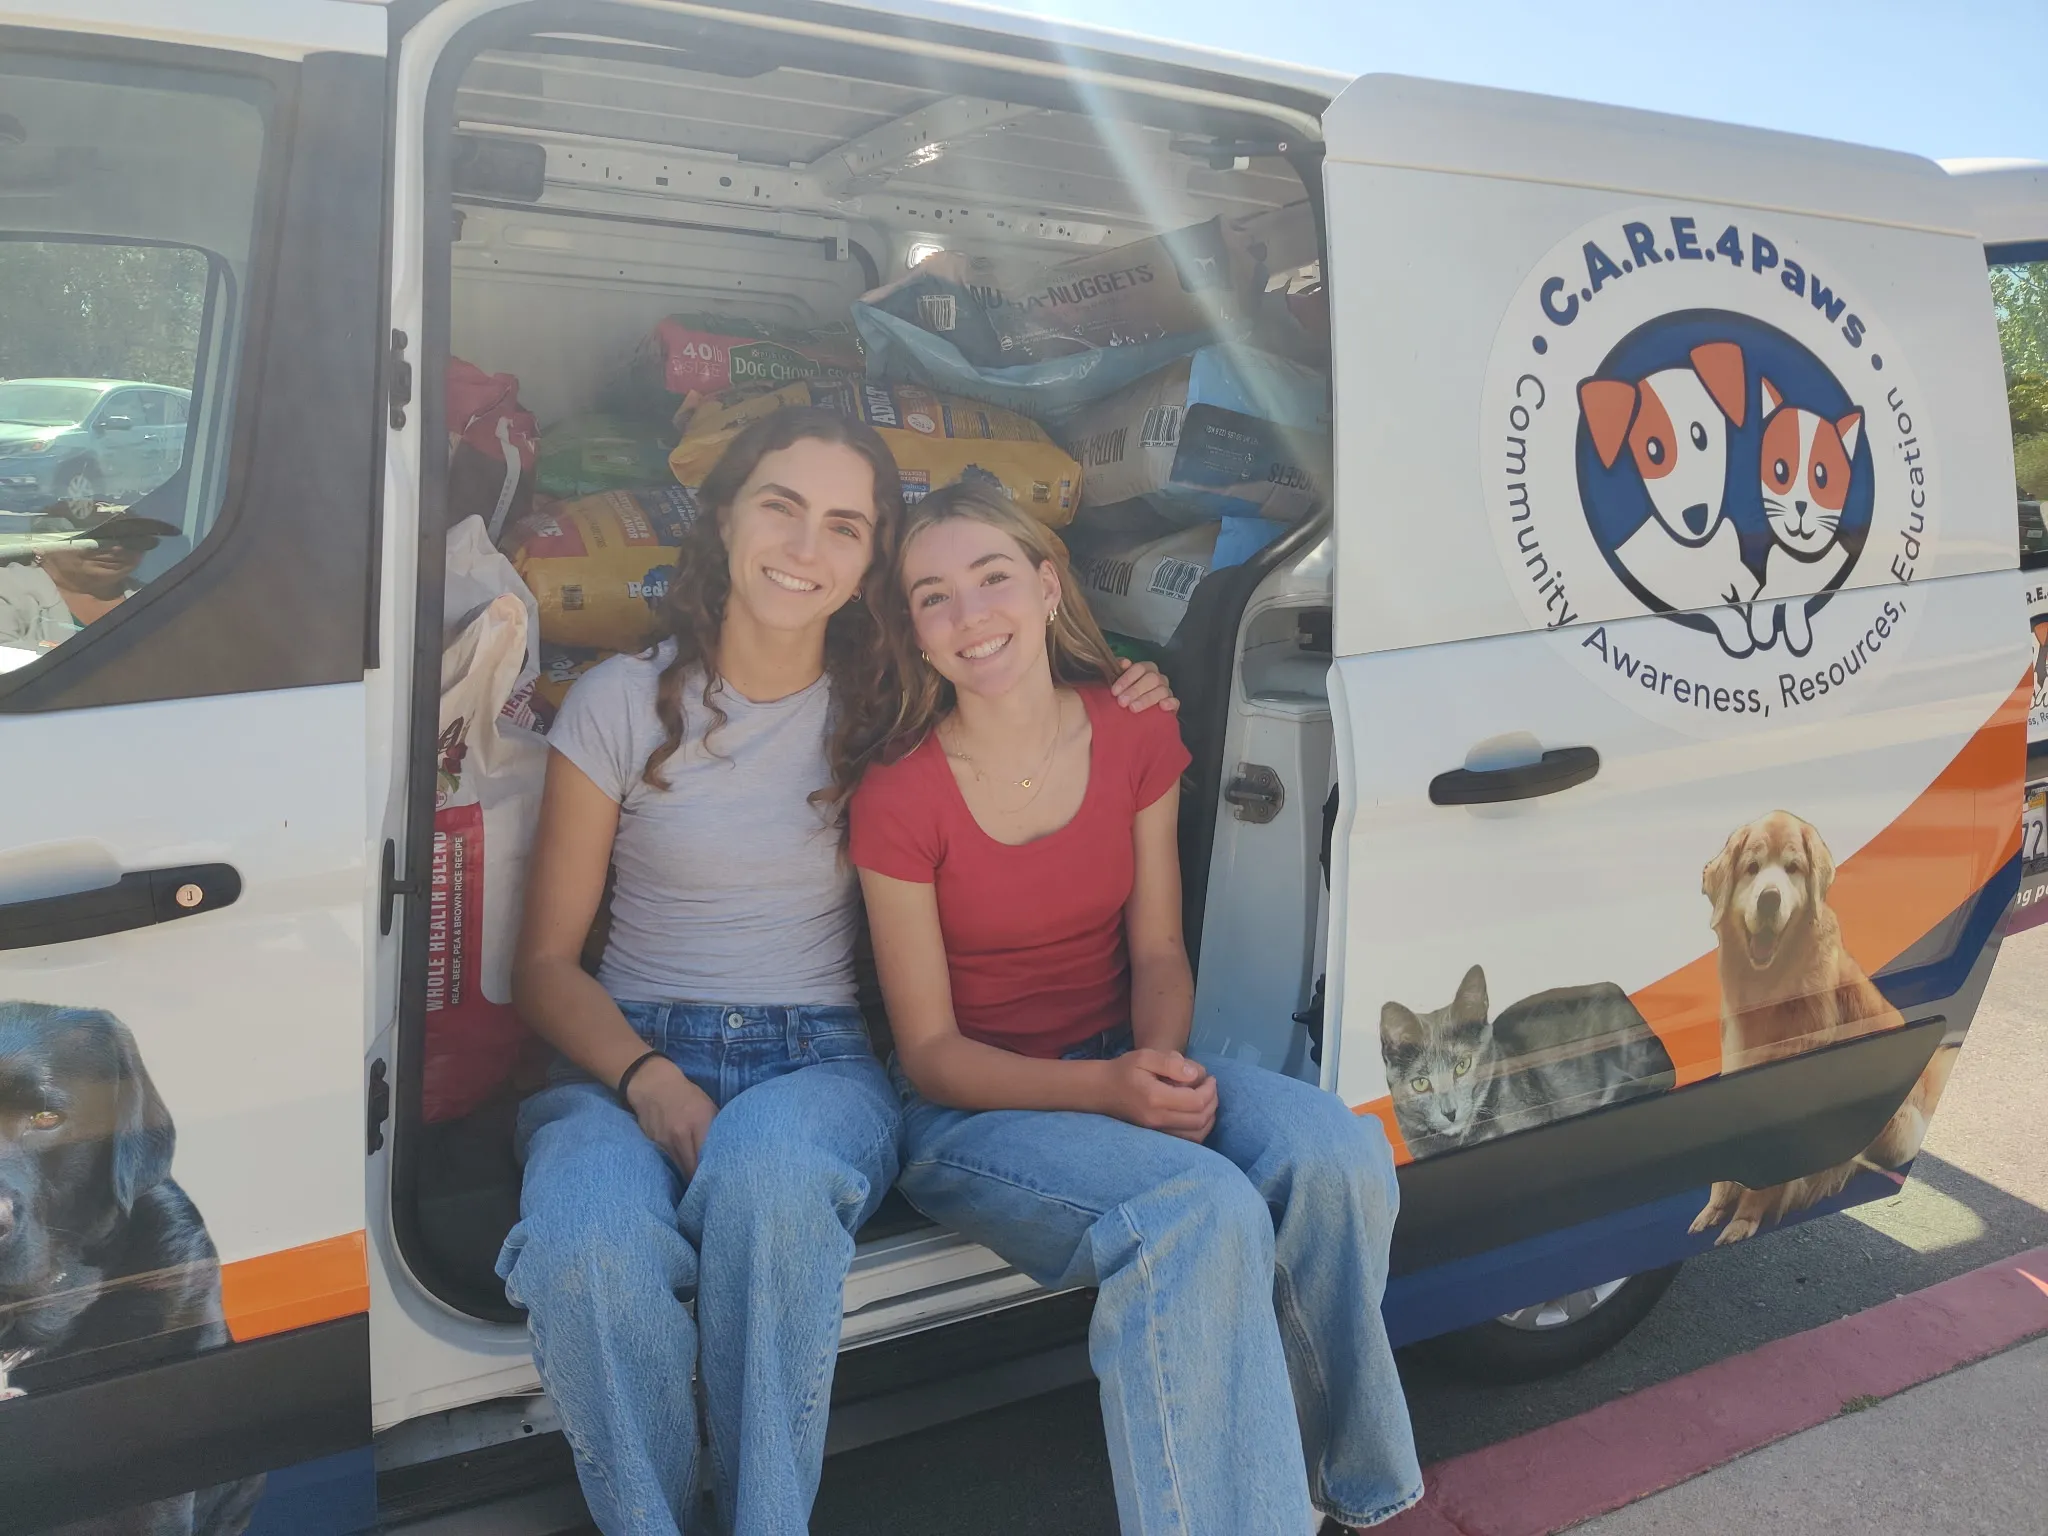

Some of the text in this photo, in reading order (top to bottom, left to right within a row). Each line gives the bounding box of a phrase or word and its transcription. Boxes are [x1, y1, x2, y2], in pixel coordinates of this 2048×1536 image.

[735, 356, 815, 381] DOG CHOW
[865, 384, 897, 426] ADULT
[1505, 373, 1926, 717] Community Awareness, Resources, Education
[628, 581, 669, 598] Pedi
[455, 836, 463, 869] RECIPE
[454, 869, 463, 891] RICE
[454, 893, 462, 928] BROWN
[453, 937, 461, 955] PEA
[453, 955, 462, 980] BEEF,
[426, 957, 445, 1012] WHOLE
[452, 981, 460, 1004] REAL
